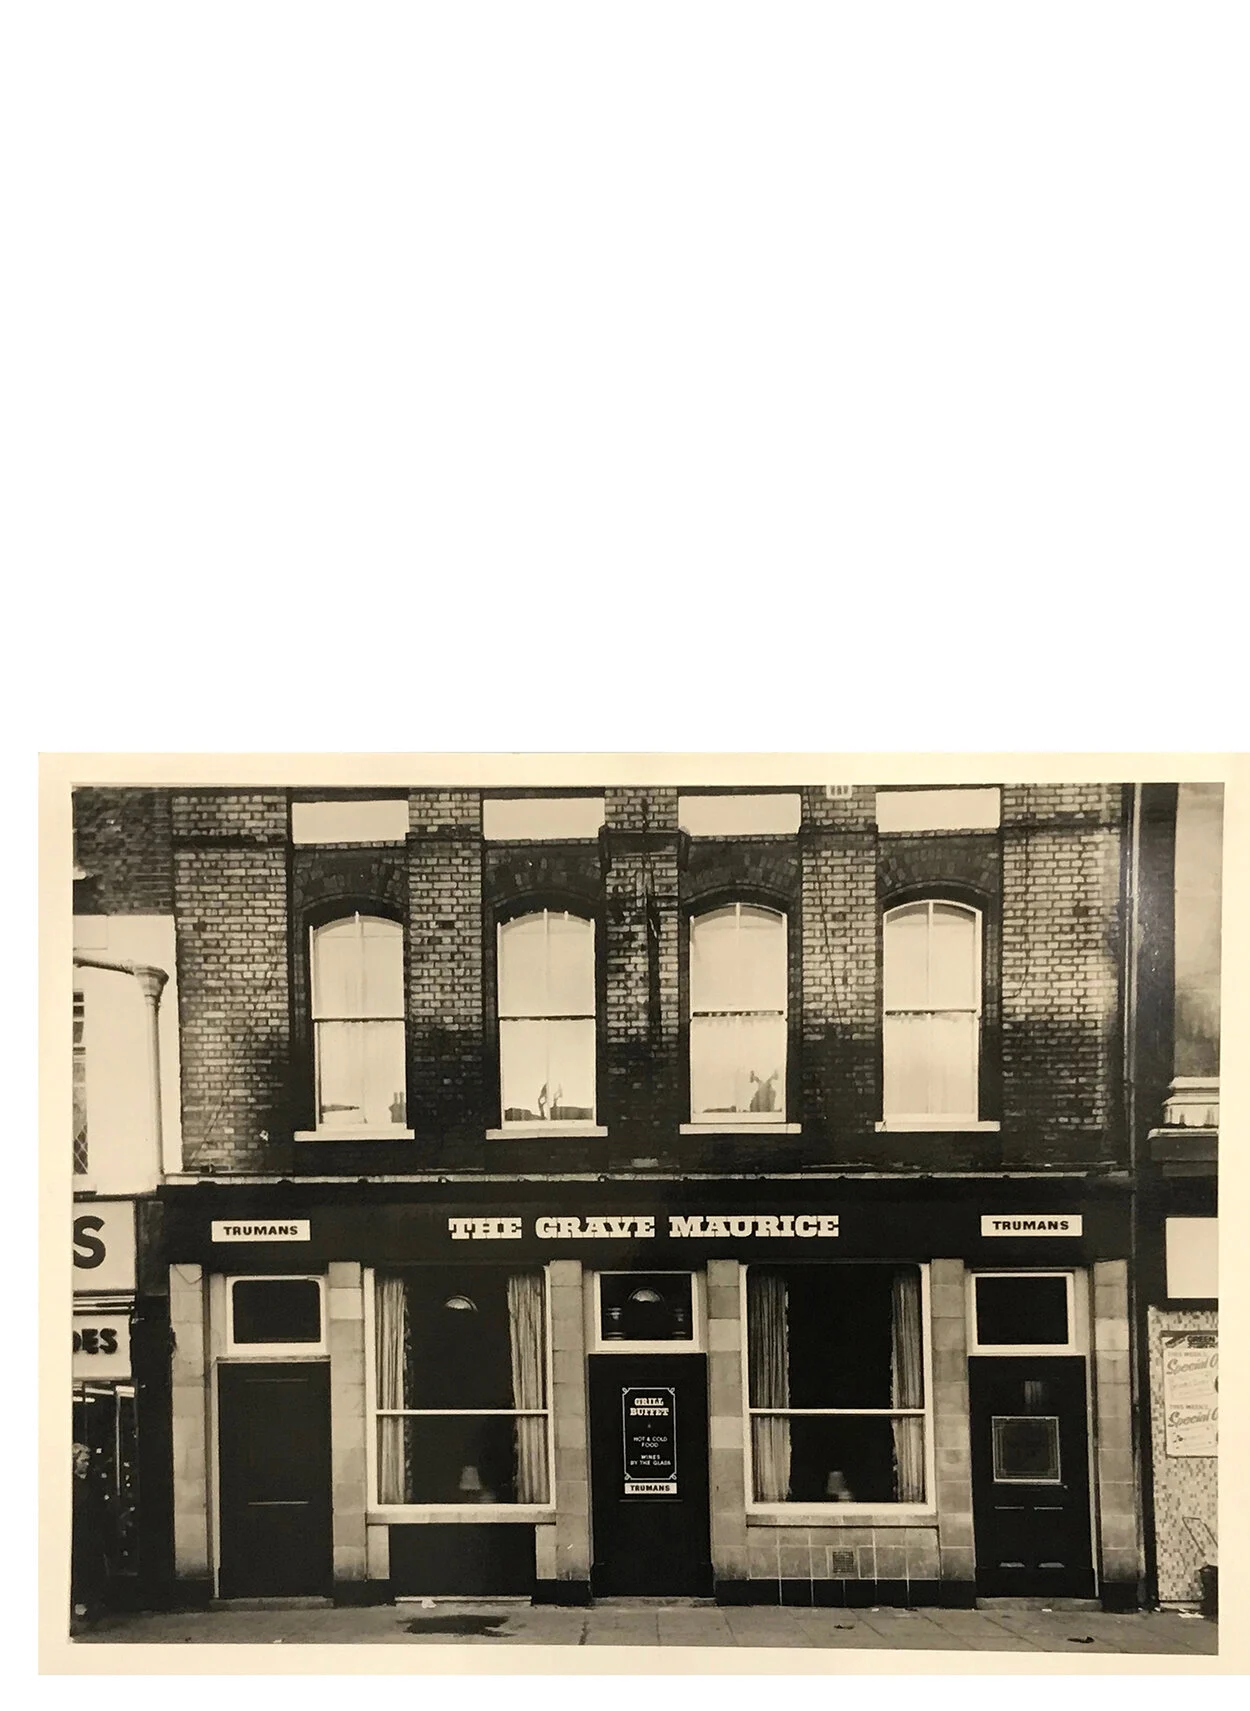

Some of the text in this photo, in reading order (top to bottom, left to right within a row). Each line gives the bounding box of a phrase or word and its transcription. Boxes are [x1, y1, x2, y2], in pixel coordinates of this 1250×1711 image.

[223, 1225, 298, 1236] TRUMANS
[448, 1214, 840, 1239] THE GRAVE MAURICE
[992, 1220, 1069, 1231] TRUMANS
[634, 1398, 664, 1406] GRILL
[630, 1408, 670, 1416] BUFFET
